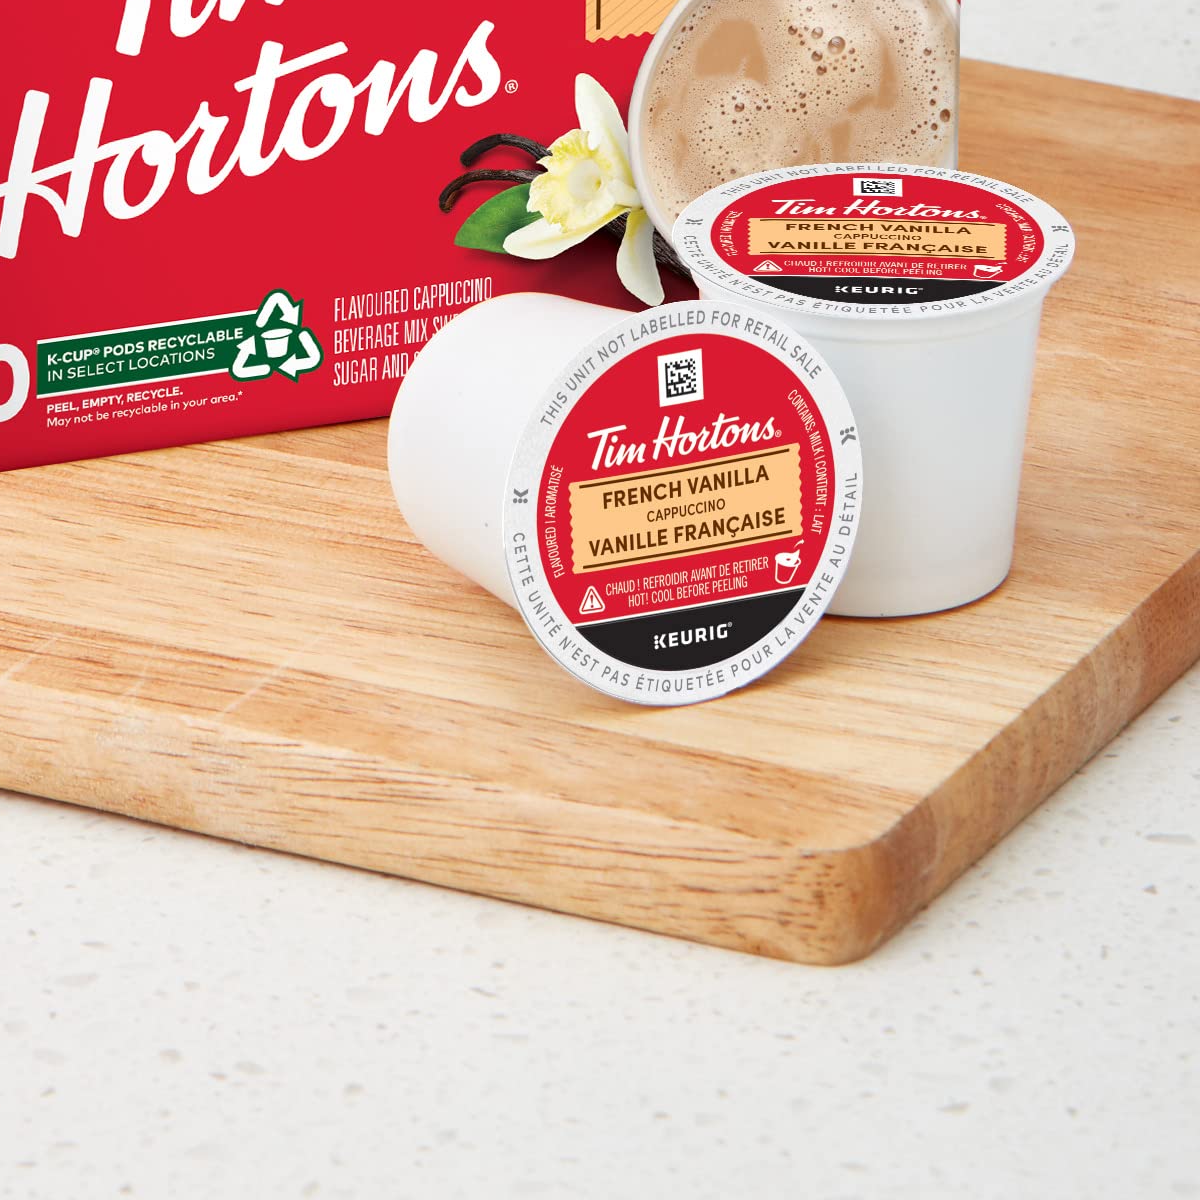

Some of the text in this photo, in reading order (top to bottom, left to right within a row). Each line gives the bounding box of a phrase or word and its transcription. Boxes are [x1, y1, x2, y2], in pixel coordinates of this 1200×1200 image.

[771, 199, 836, 215] Tim
[786, 223, 972, 235] FRENCH VANILLA
[768, 242, 987, 254] VANILLE FRANÇAISE
[334, 276, 492, 321] FLAVOURED CAPPUCCINO
[775, 294, 806, 306] PAS
[812, 302, 911, 314] ÉTIQUETÉE
[920, 300, 966, 312] POUR
[102, 340, 143, 357] PODS
[147, 328, 243, 351] RECYCLABLE
[334, 322, 399, 354] BEVERAGE
[404, 317, 428, 344] MIX
[48, 348, 214, 381] IN SELECT LOCATIONS
[333, 356, 377, 386] SUGAR
[381, 351, 408, 379] AND
[540, 310, 822, 426] THIS UNIT NOT LABELLED FOR RETAIL SALE
[46, 386, 183, 414] PEEL, EMPTY, RECYCLE.
[47, 415, 71, 428] May
[73, 411, 93, 423] not
[96, 409, 109, 420] be
[112, 402, 167, 418] recyclable
[171, 399, 180, 410] in
[183, 398, 207, 410] your
[587, 425, 647, 471] Tim
[787, 389, 828, 534] CONTAINS: MILK CONTIENT LAIT
[602, 465, 769, 509] FRENCH VANILLA
[545, 465, 565, 579] FLAVOURED AROMATISÉ
[646, 497, 725, 523] CAPPUCCINO
[588, 507, 785, 558] VANILLE FRANÇAISE
[513, 472, 858, 692] CETTE UNITÉ N'EST PAS ÉTIQUETÉE POUR LA VENTE AU DÉTAIL
[605, 578, 635, 596] CHAUD
[642, 569, 687, 589] REFROIDIR
[690, 564, 716, 581] AVANT
[718, 562, 729, 576] DE
[732, 555, 768, 574] RETIRER
[628, 575, 747, 608] HOT! COOL BEFORE PEELING
